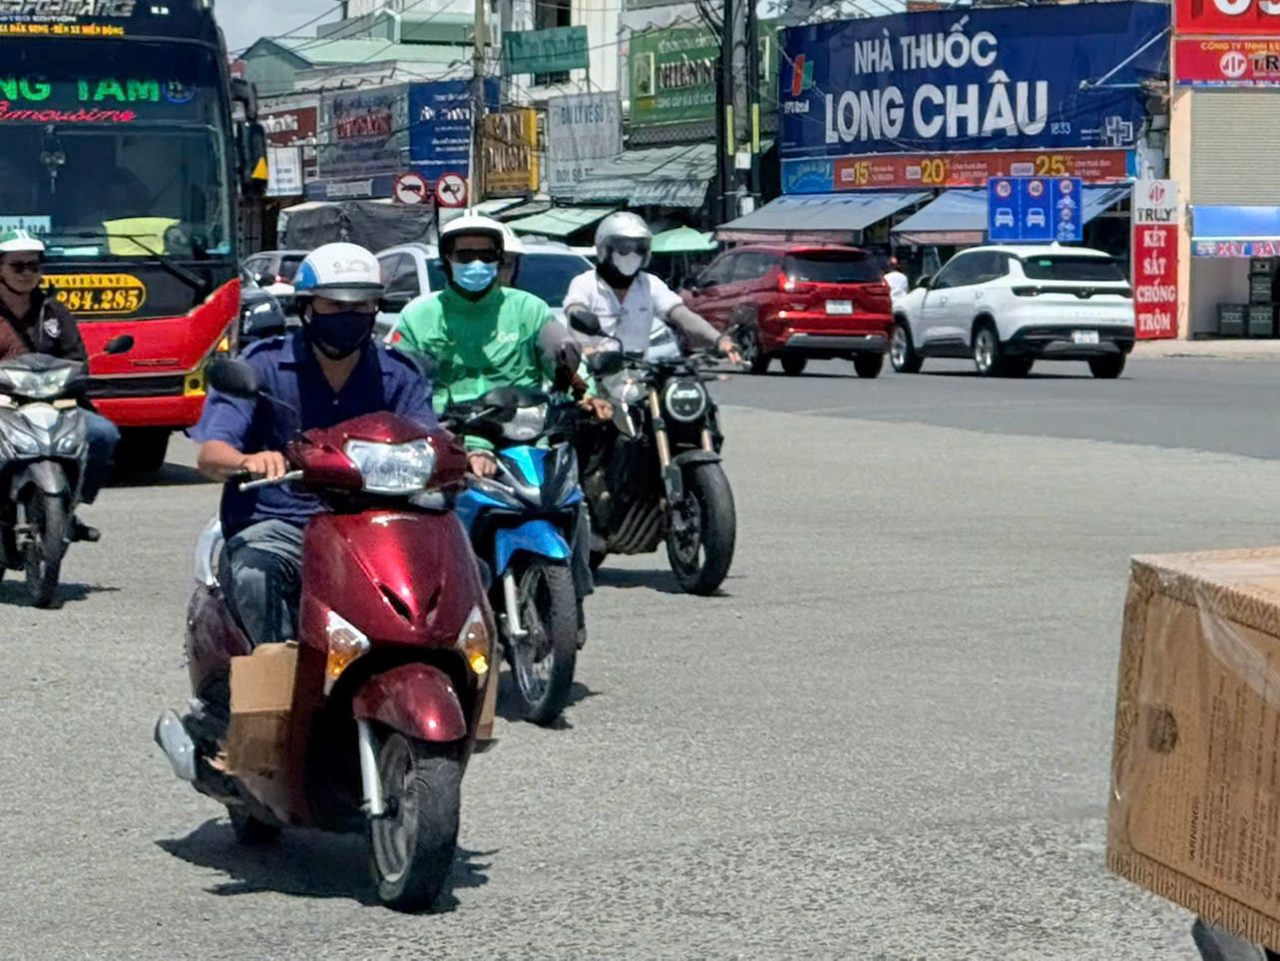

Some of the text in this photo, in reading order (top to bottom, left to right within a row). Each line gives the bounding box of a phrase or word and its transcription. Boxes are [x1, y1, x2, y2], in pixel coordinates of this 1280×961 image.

[854, 14, 997, 74] NHÀ THUỐC
[825, 69, 1048, 144] LONG CHÂU
[1051, 122, 1072, 135] 1833
[1137, 208, 1173, 221] TRULY
[1136, 278, 1176, 303] CHỐNG
[1138, 308, 1171, 335] TRỘM
